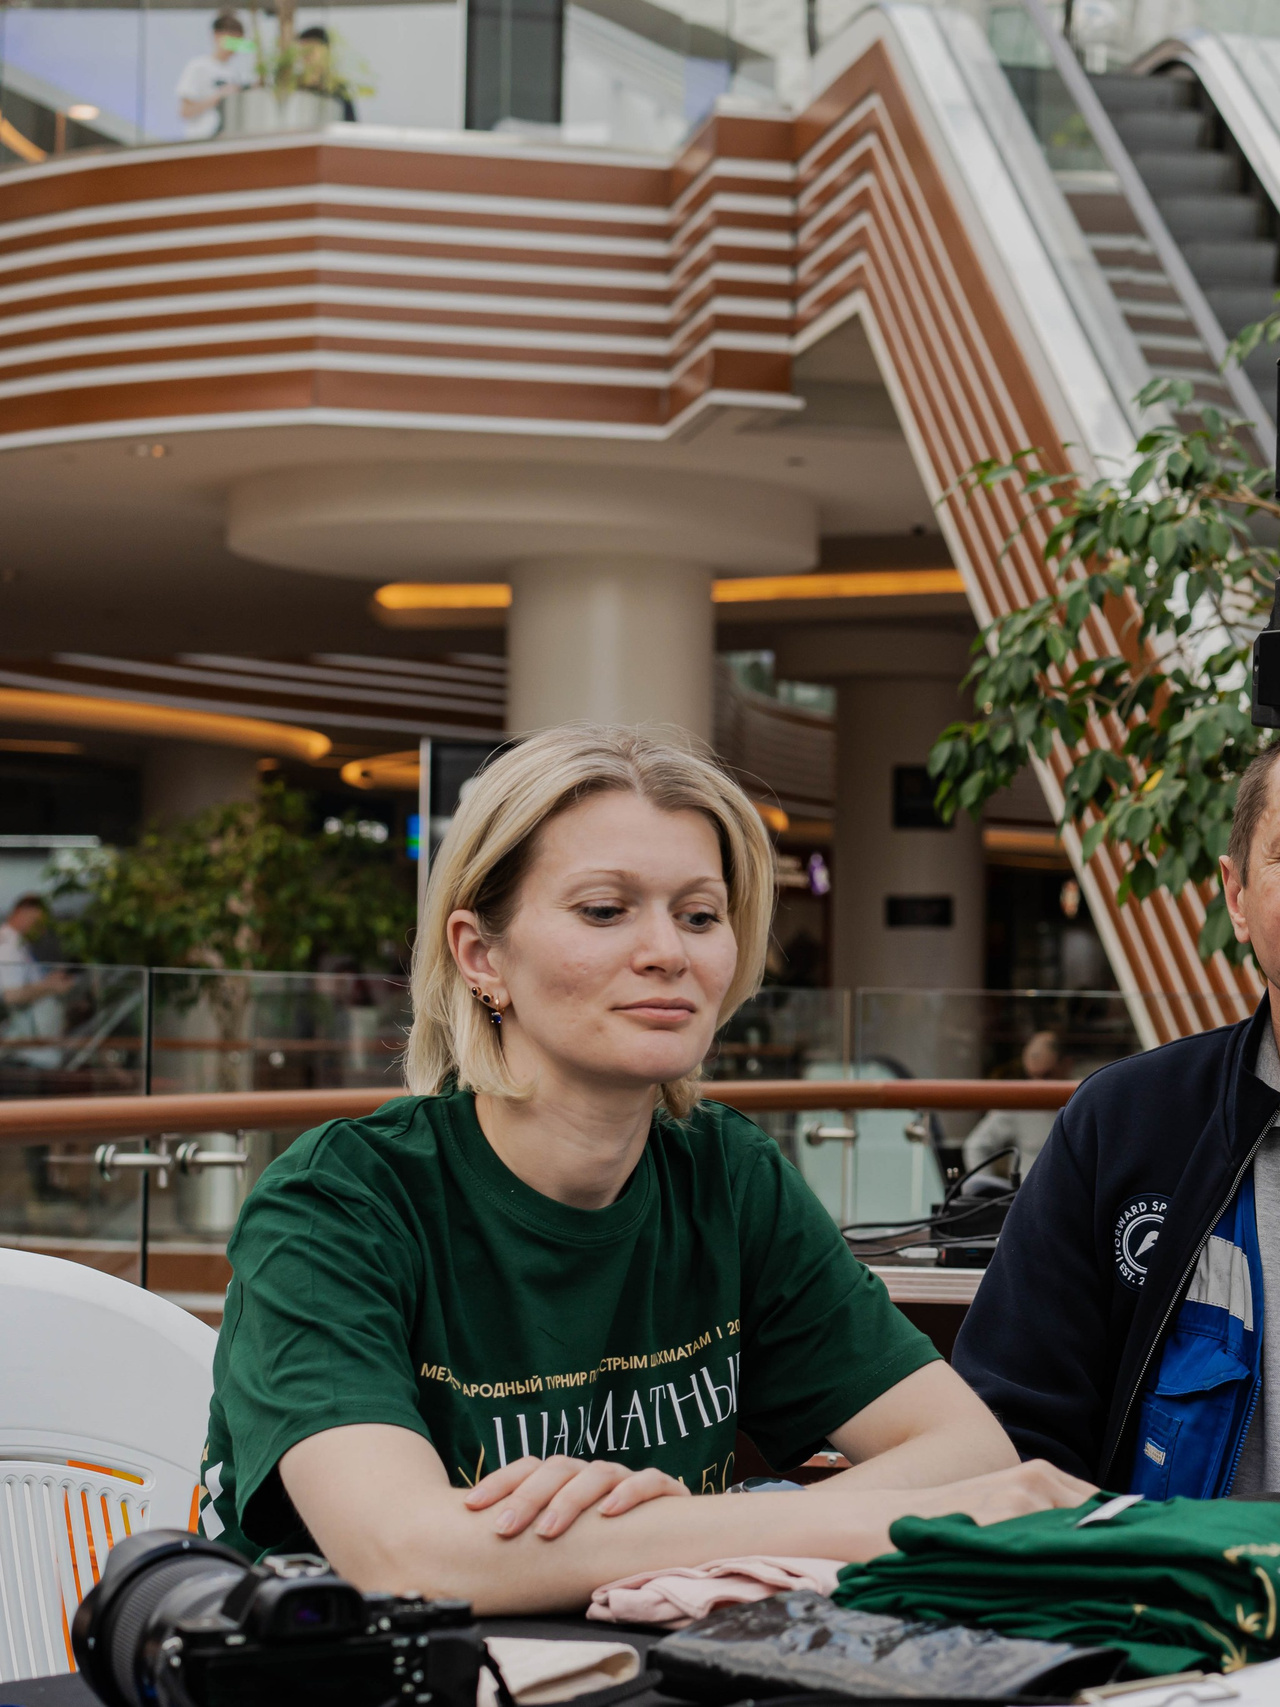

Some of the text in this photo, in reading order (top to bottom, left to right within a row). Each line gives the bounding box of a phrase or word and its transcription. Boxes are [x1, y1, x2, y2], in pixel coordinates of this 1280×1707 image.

[1114, 1200, 1168, 1256] FORWARD SP
[1119, 1262, 1136, 1284] EST.
[492, 1351, 741, 1468] ШАХМАТНЫ
